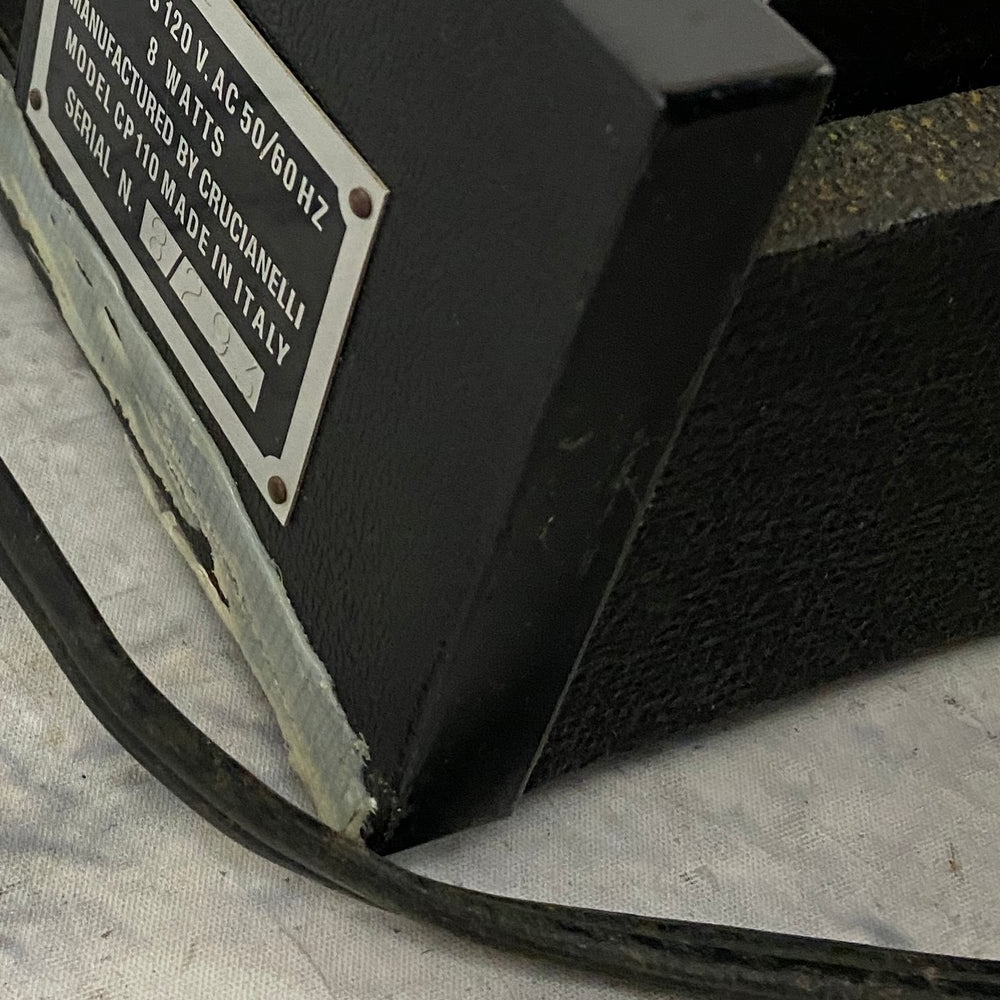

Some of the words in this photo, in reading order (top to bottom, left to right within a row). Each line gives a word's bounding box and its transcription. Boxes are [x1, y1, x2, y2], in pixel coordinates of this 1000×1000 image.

[64, 85, 111, 179] SERIAL
[117, 167, 132, 213] N.
[146, 35, 159, 67] 8
[164, 58, 226, 158] WATTS
[164, 0, 193, 55] 120
[211, 66, 239, 116] AC
[239, 100, 298, 192] 50/60
[296, 174, 330, 232] HZ
[64, 25, 111, 114] MODEL
[160, 168, 211, 257] MADE
[211, 244, 233, 289] IN
[233, 276, 291, 367] ITALY
[176, 134, 199, 180] BY
[199, 168, 306, 331] CRUCIANELLI
